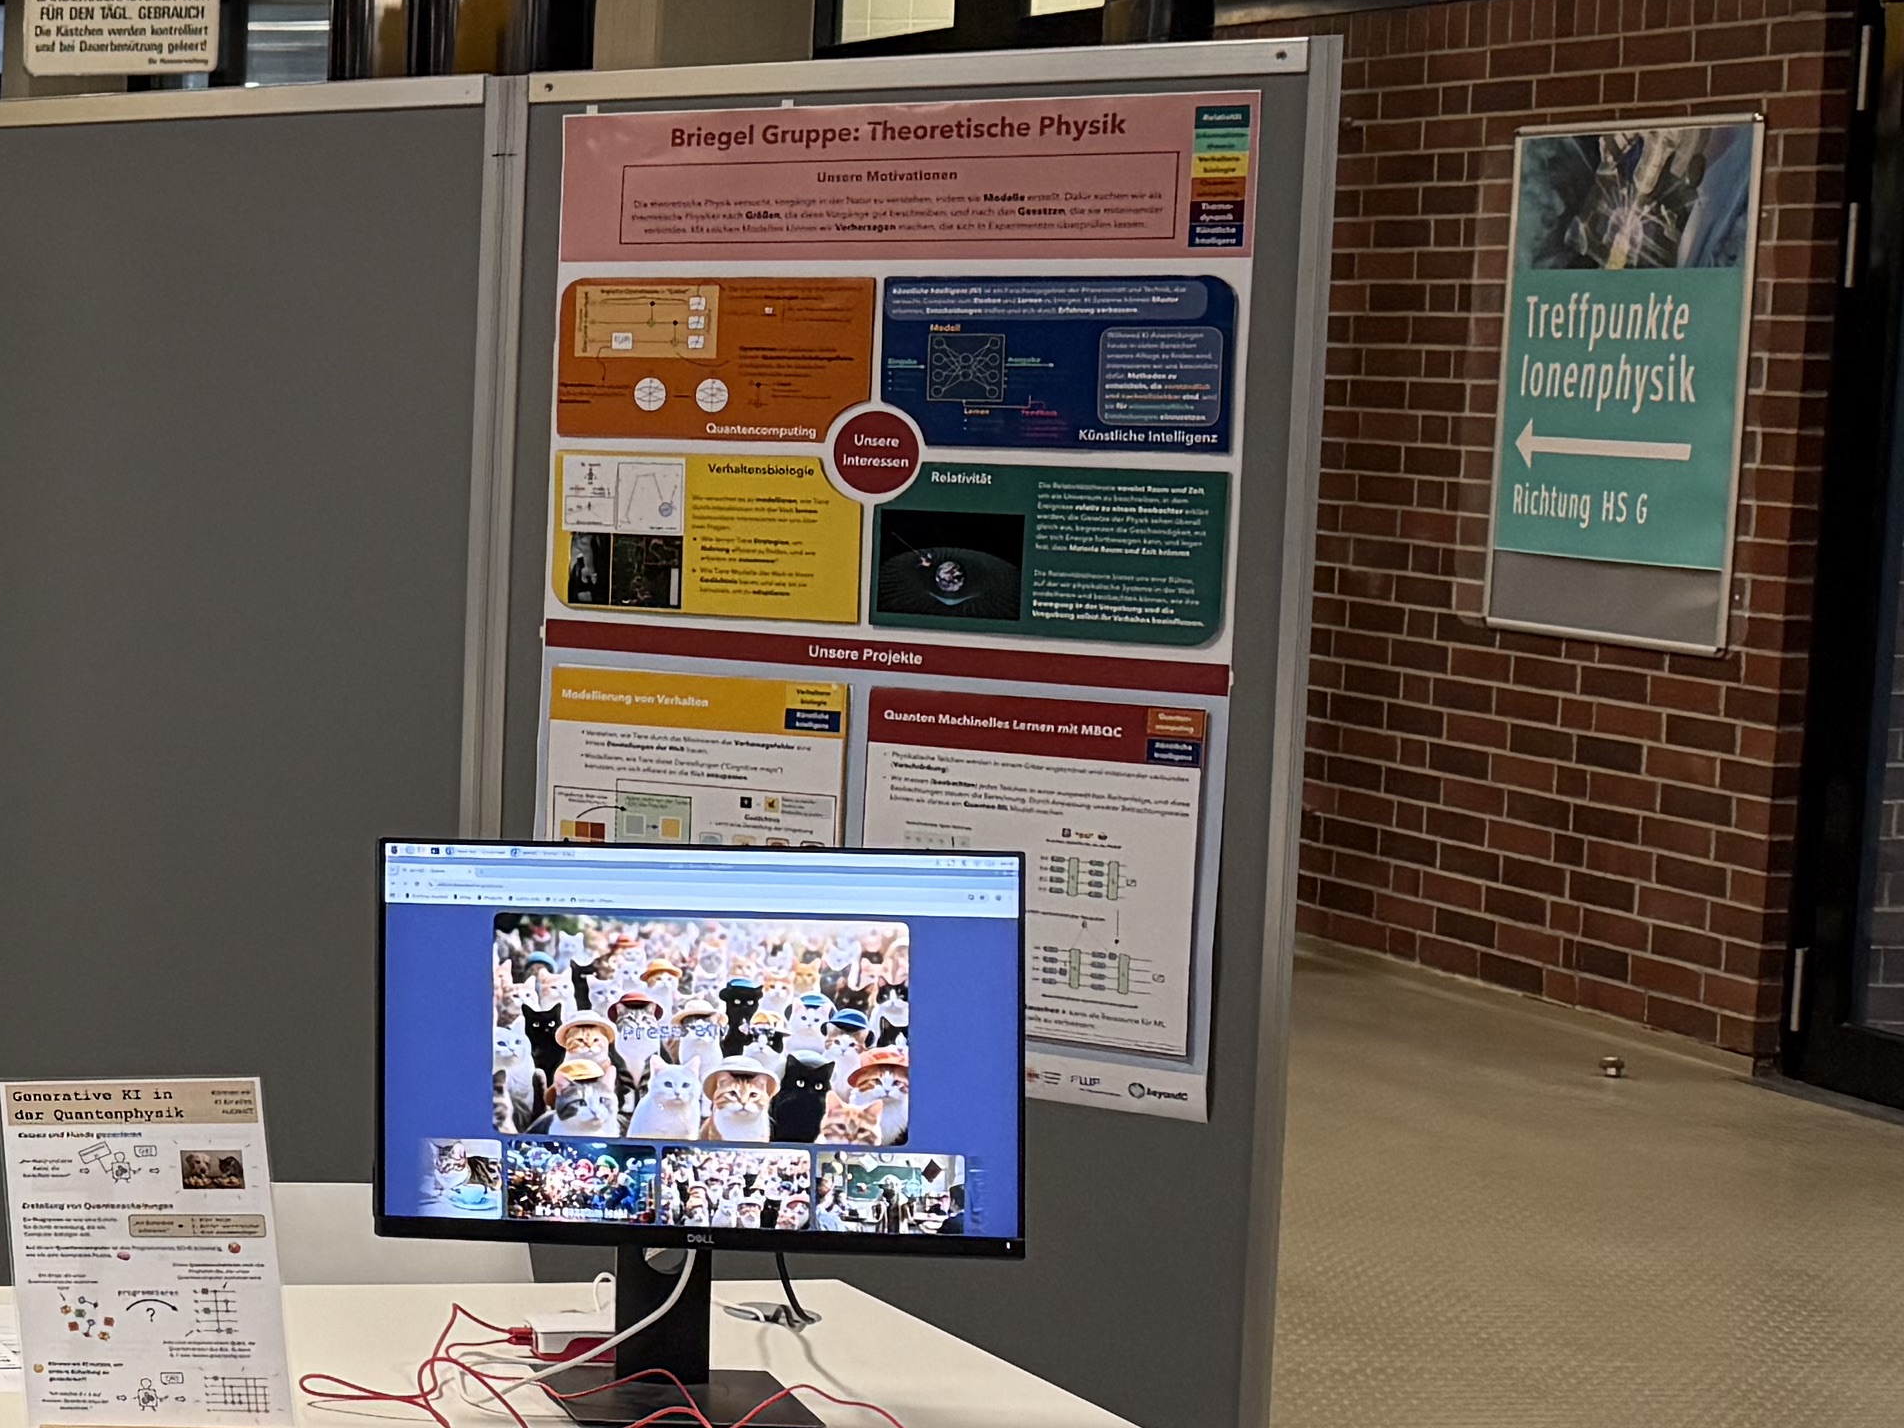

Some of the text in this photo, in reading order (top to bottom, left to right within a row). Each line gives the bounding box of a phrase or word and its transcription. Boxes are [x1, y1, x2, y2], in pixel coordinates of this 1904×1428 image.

[41, 5, 63, 20] FÜR
[70, 7, 94, 19] DEN
[138, 6, 205, 19] GEBRAUCH
[35, 25, 208, 37] Die Kästchen werden kontrolliert
[36, 42, 55, 52] und
[59, 41, 75, 52] bei
[671, 112, 1125, 151] Briegel Gruppe: Theoretische Physik
[817, 169, 957, 183] Unsere Motivationen
[1527, 292, 1689, 352] Treffpunkte
[1521, 353, 1695, 413] Ionenphysik
[706, 422, 817, 440] Quantencomputing
[1078, 429, 1218, 446] Künstliche Intelligenz
[854, 434, 899, 448] Unsere
[843, 453, 909, 468] Interessen
[708, 463, 815, 477] Verhaltensbiologie
[931, 471, 992, 485] Relativität
[1513, 483, 1648, 528] Richtung HS G
[808, 644, 923, 665] Unsere Projekte
[562, 689, 709, 708] Modellierung von Verhalten
[884, 710, 1122, 738] Quanten Machinelles Lernen mit MBQC
[12, 1088, 172, 1103] Generative KI in
[14, 1106, 184, 1123] der Quantenphysik
[687, 1233, 715, 1244] DELL
